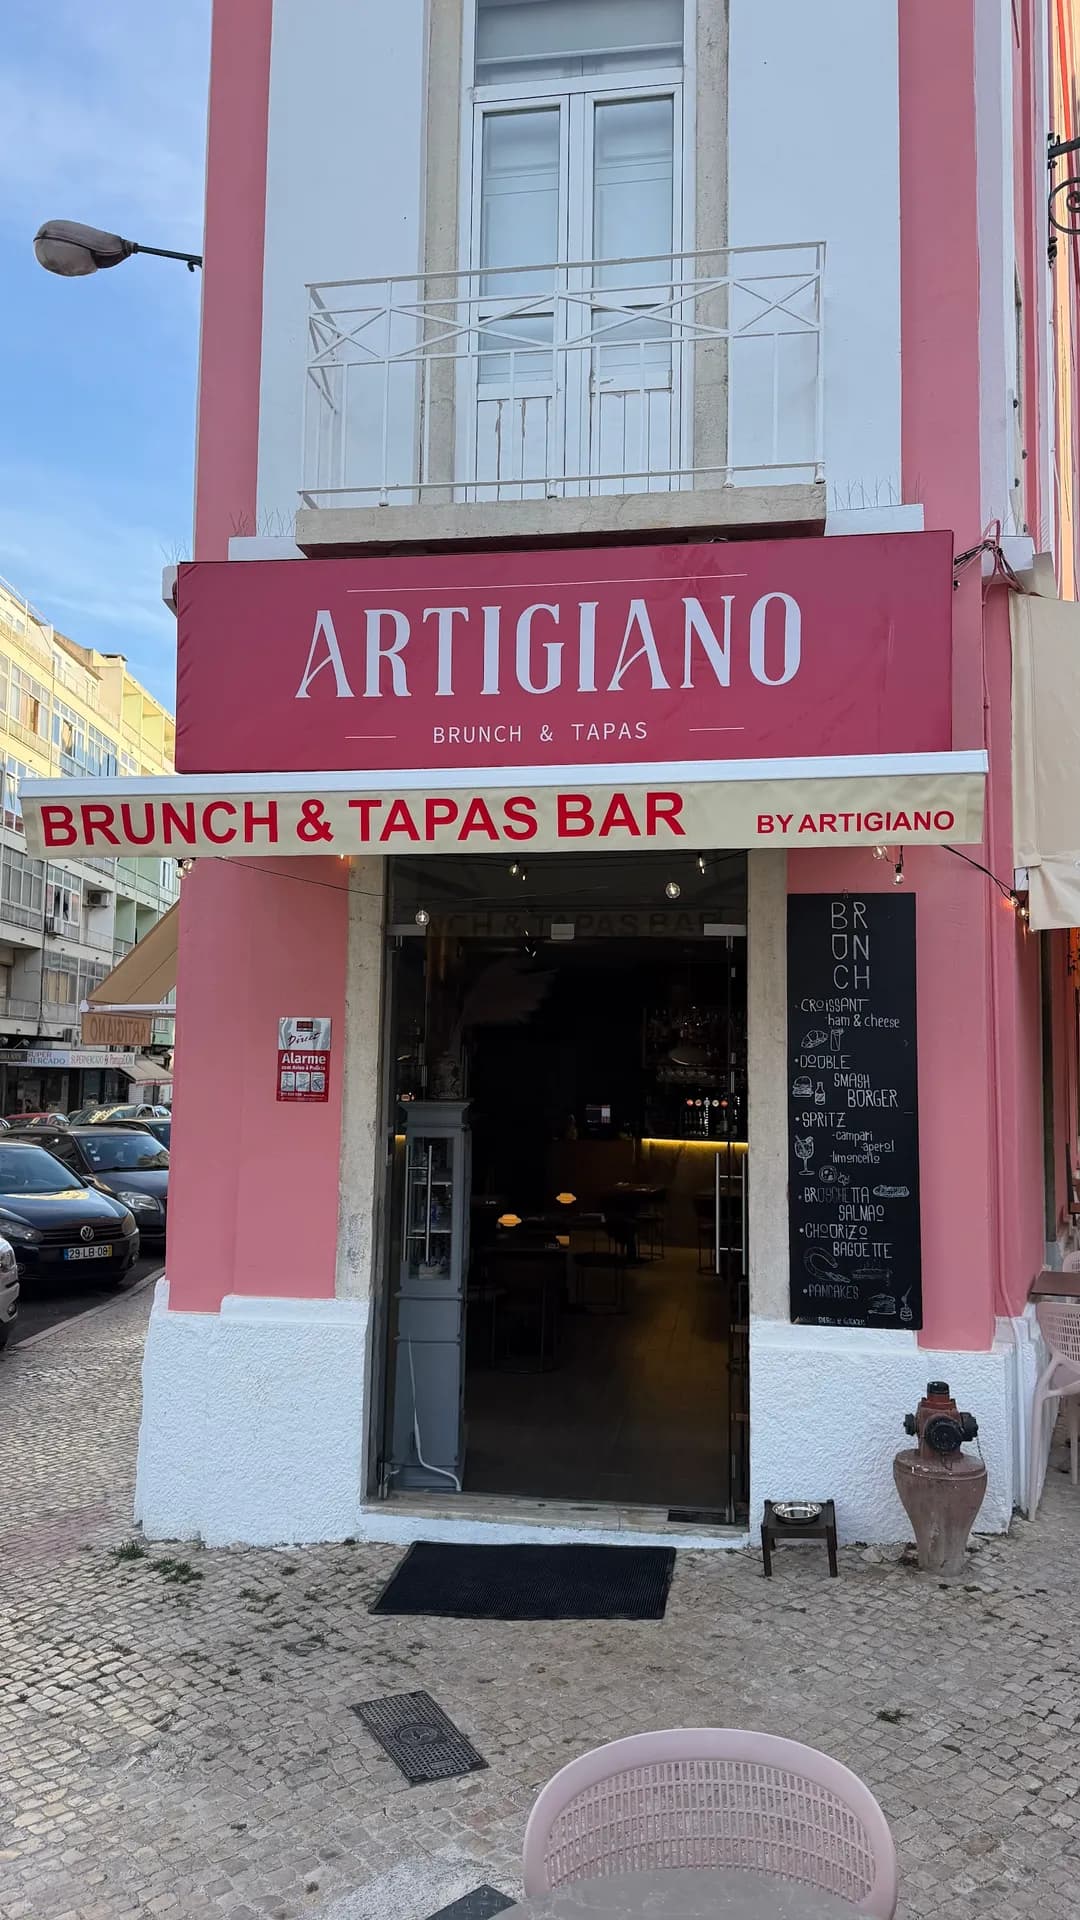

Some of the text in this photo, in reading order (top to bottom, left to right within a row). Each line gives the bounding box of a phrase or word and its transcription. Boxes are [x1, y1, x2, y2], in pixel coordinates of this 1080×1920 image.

[295, 591, 802, 698] ARTIGIANO
[433, 721, 648, 745] BRUNCH & TAPAS
[41, 792, 686, 847] BRUNCH & TAPAS BAR
[757, 810, 955, 834] BY ARTIGIANO
[853, 1014, 862, 1027] &
[864, 1013, 900, 1028] cheese
[281, 1052, 327, 1065] Alarme
[800, 1055, 851, 1070] DOUBLE
[833, 1072, 871, 1089] SMASH
[847, 1088, 899, 1108] BURGER
[832, 1242, 894, 1259] BAGUETTE
[808, 1284, 859, 1300] PANCAKES
